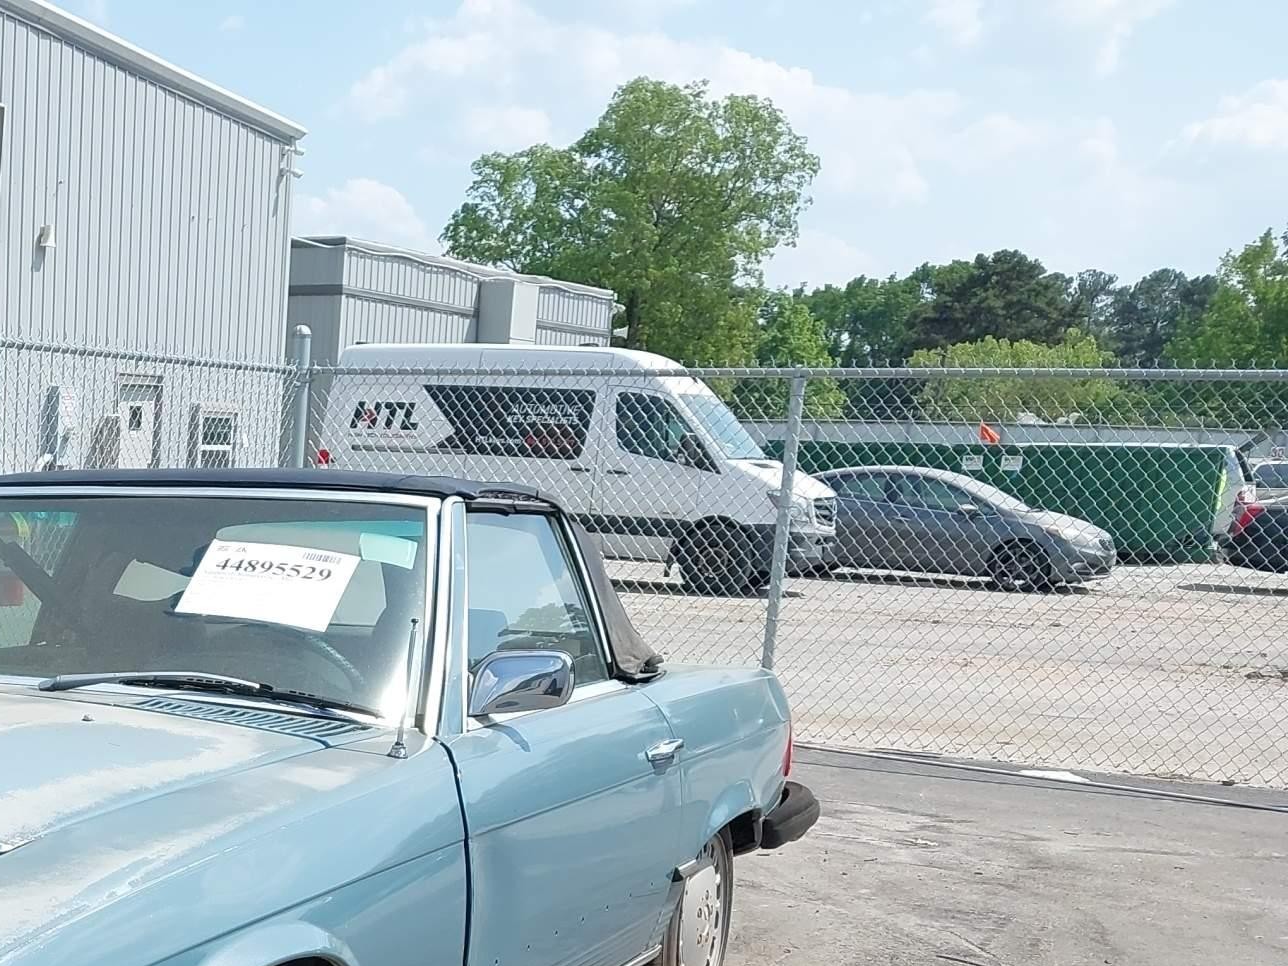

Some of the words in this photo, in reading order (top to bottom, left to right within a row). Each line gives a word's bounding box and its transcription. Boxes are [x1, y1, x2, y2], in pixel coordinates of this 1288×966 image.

[349, 400, 419, 430] HTL
[512, 402, 581, 416] AUTOMOTIVE
[215, 557, 333, 582] 44895529
